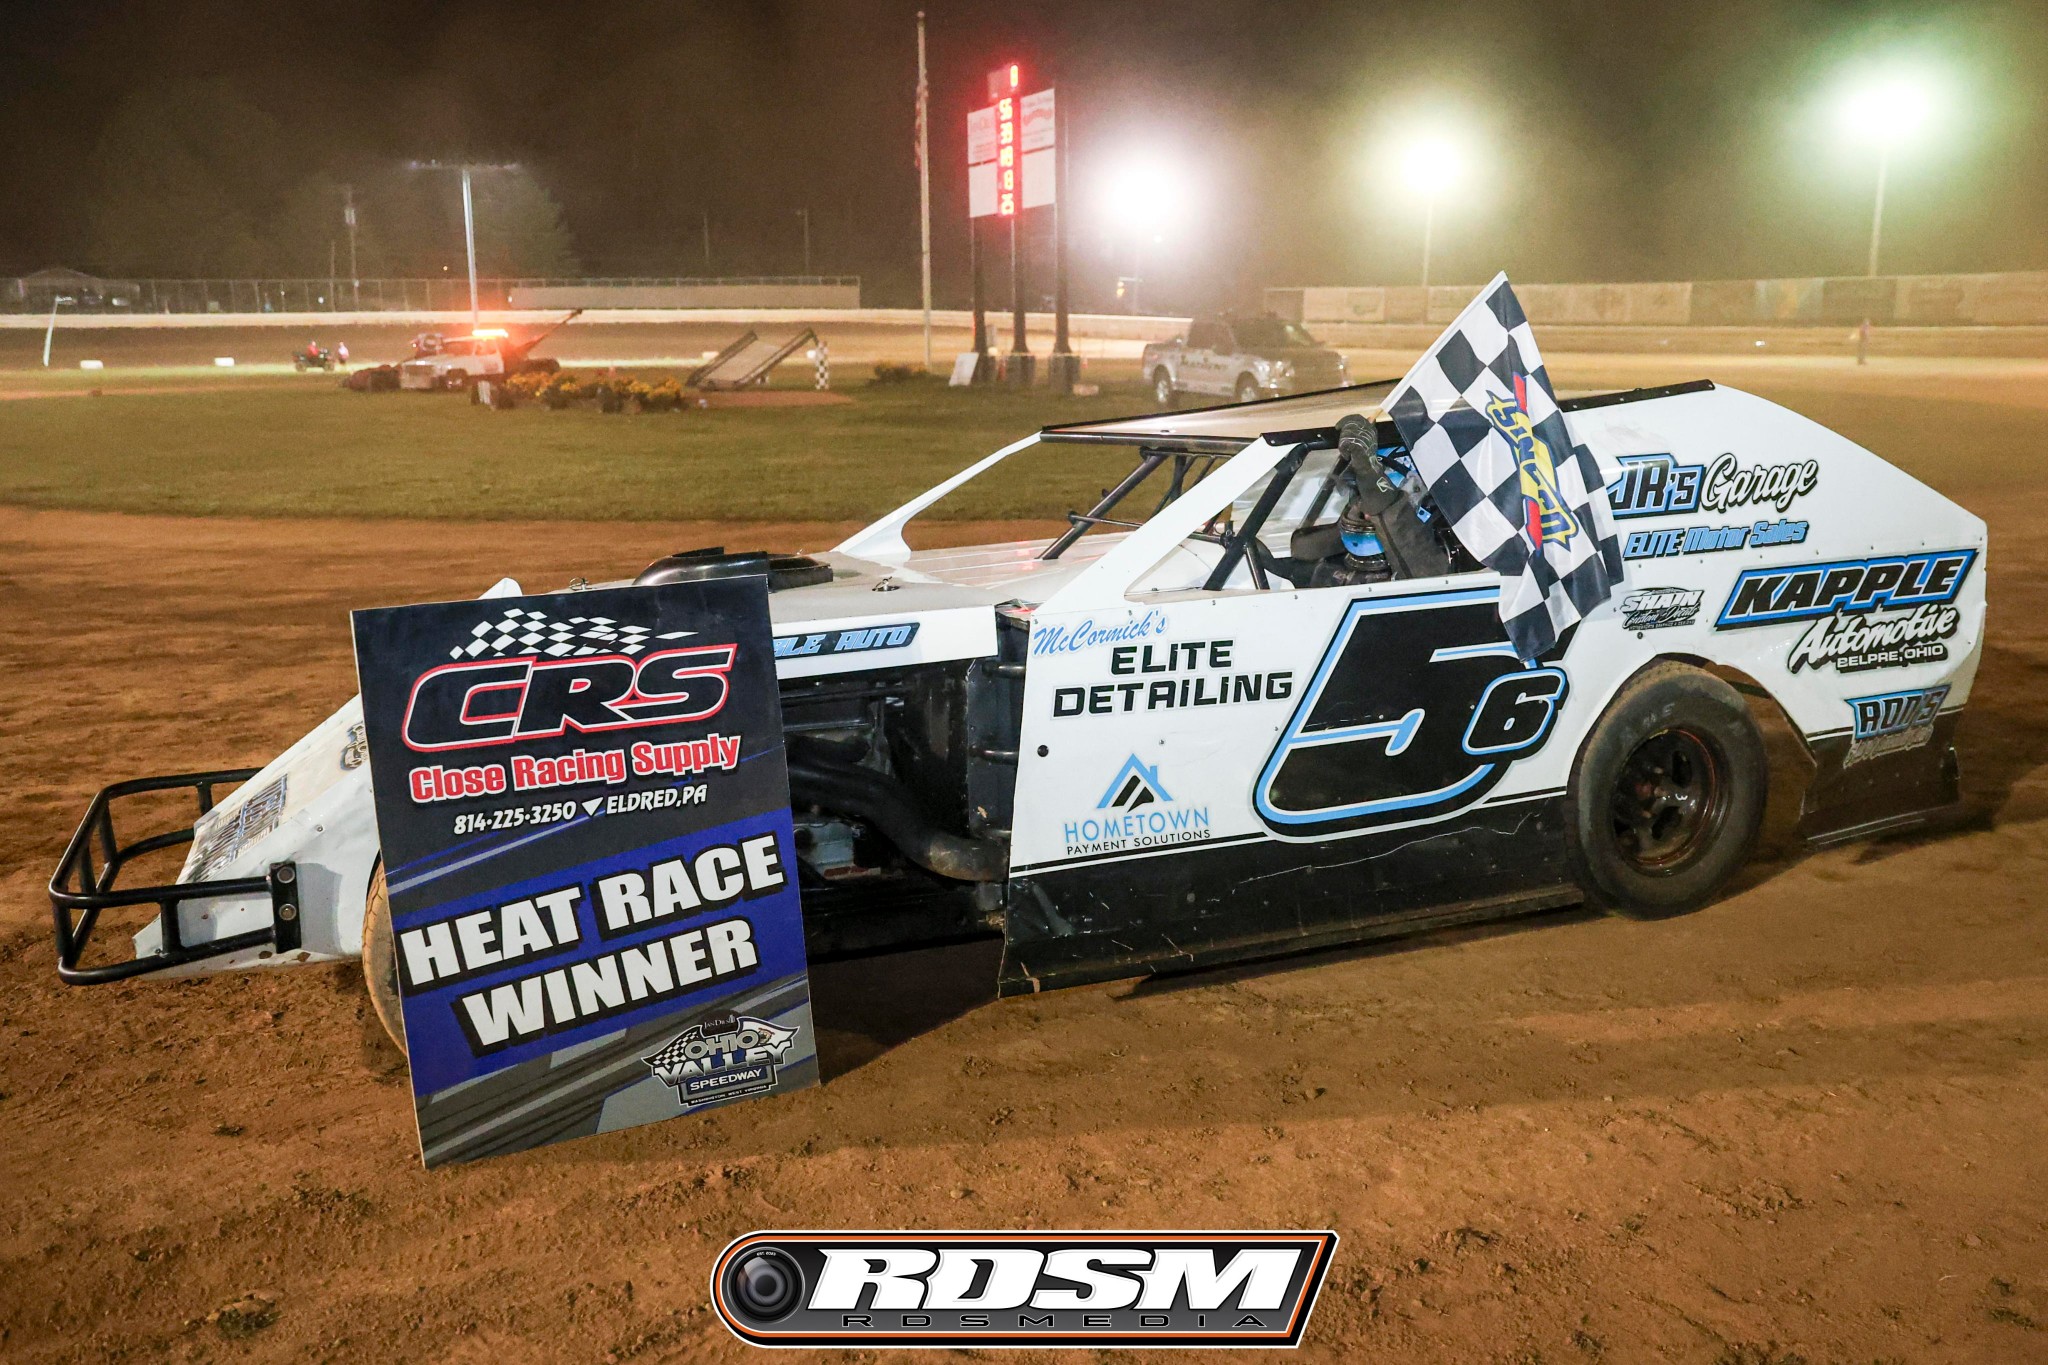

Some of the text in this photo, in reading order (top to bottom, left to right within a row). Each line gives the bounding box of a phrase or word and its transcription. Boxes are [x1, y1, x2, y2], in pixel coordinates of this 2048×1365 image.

[1701, 453, 1819, 513] Garage
[1623, 519, 1810, 560] ELITE Motor Sales
[1721, 553, 1973, 624] KAPPLE
[834, 625, 911, 651] AUTO
[1032, 610, 1167, 656] McCormick's
[1790, 604, 1957, 671] Automotive
[1111, 639, 1234, 676] ELITE
[403, 644, 738, 752] CRS
[1053, 671, 1293, 717] DETAILING
[410, 734, 741, 803] Close Racing Supply
[1064, 807, 1210, 843] HOMETOWN
[1066, 828, 1211, 856] PAYMENT SOLUTIONS
[400, 835, 784, 986] HEAT RACE
[462, 919, 758, 1046] WINNER
[654, 1041, 791, 1085] VALLEY
[684, 1030, 760, 1060] OHIO
[690, 1069, 762, 1091] SPEEDWAY
